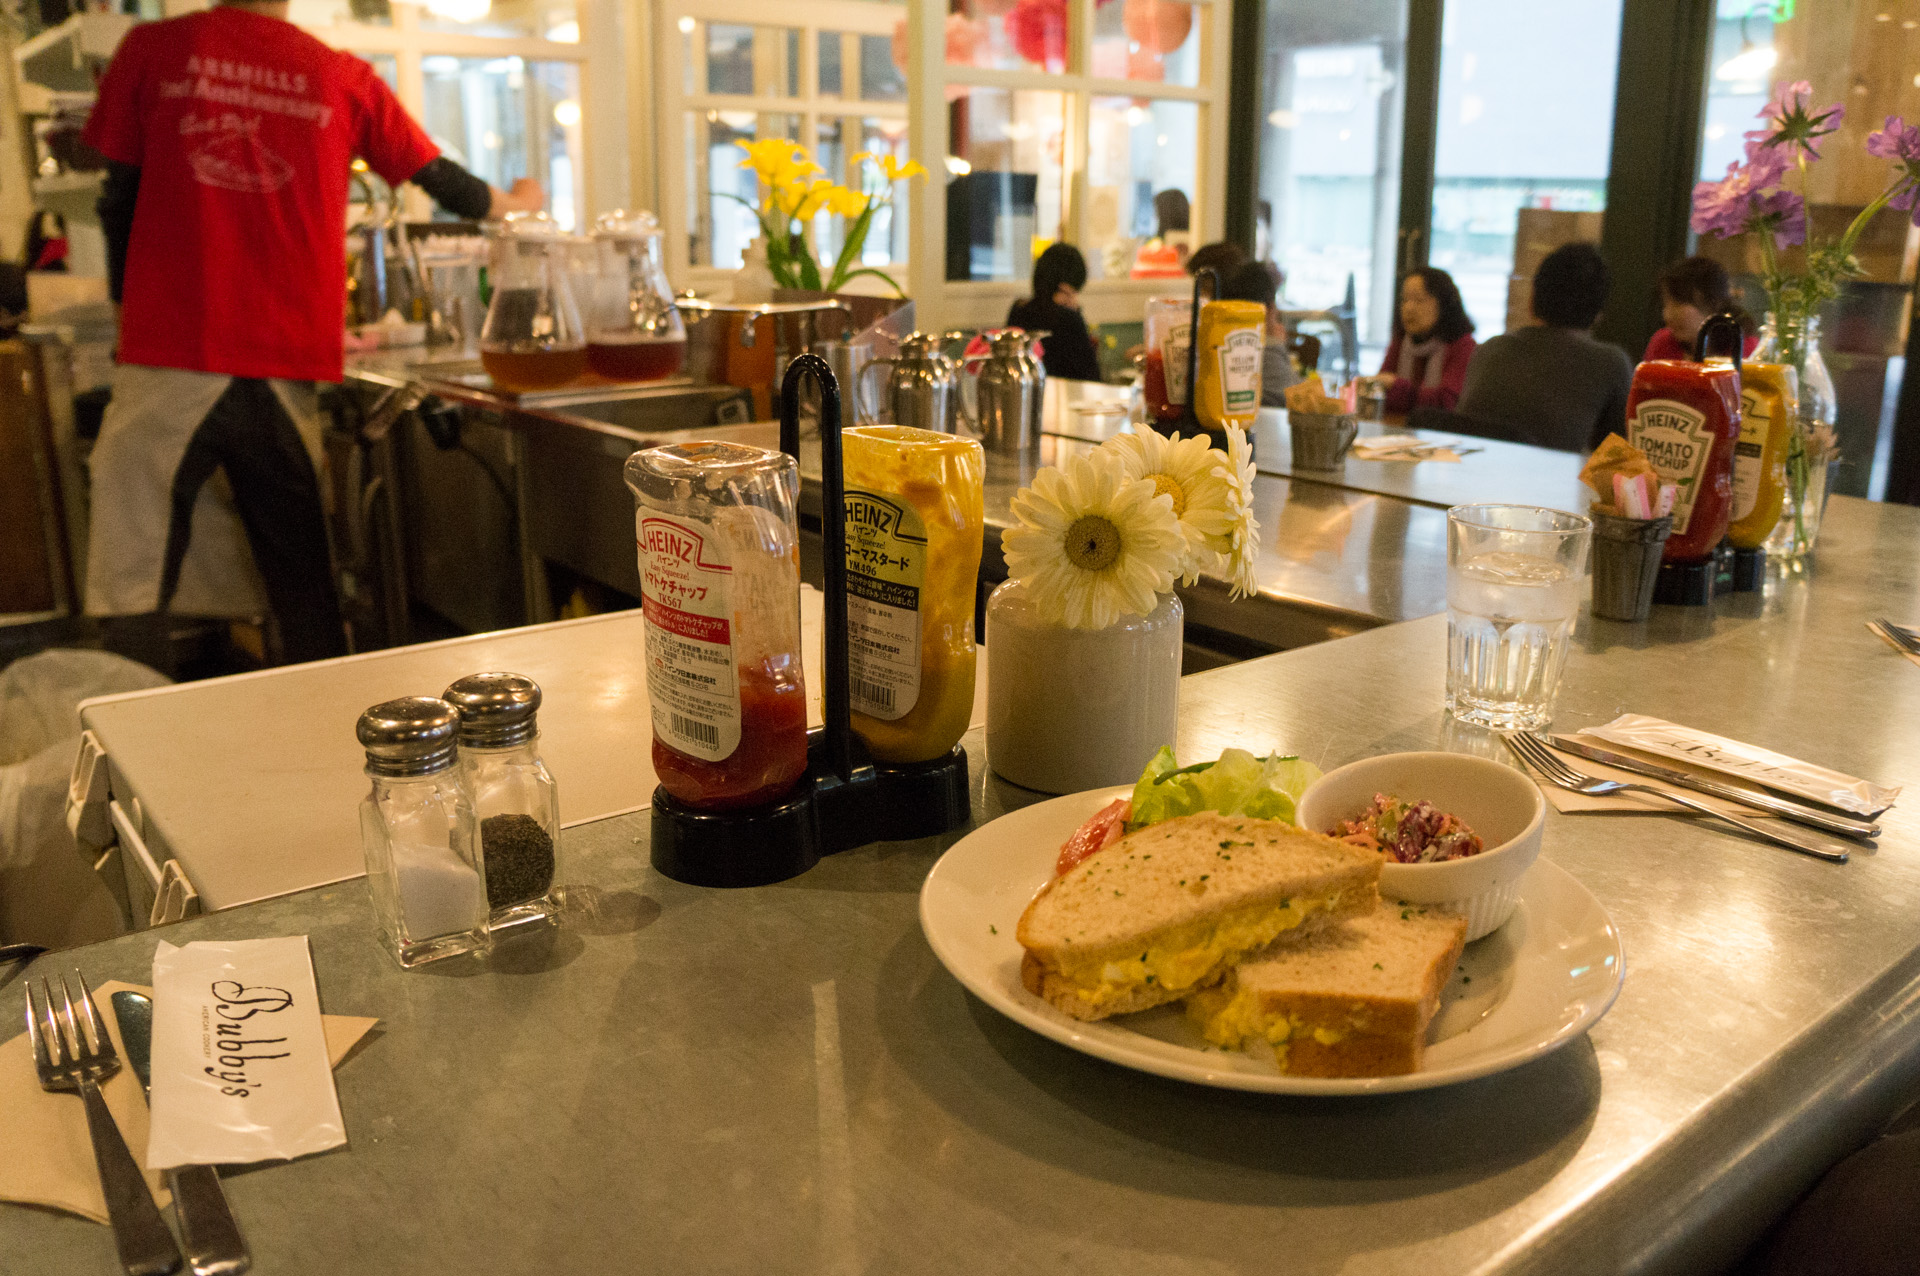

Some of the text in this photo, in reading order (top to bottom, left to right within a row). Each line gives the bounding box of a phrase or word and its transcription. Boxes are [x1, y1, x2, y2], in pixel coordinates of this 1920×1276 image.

[1647, 414, 1690, 433] HEINZ
[1639, 436, 1694, 459] TOMATO
[1647, 453, 1689, 470] TCHUP
[845, 502, 892, 534] HEINZ
[852, 525, 878, 537] ハインツ
[647, 530, 693, 564] HEINZ
[857, 535, 885, 550] Squeeze!
[657, 555, 681, 568] ハインツ
[849, 559, 877, 576] YM496
[661, 566, 690, 581] Squeeze!
[644, 568, 709, 601] トマトケチャップ
[658, 592, 682, 609] TK567
[202, 1004, 211, 1032] AMERICAN
[204, 980, 294, 1099] Bubby's
